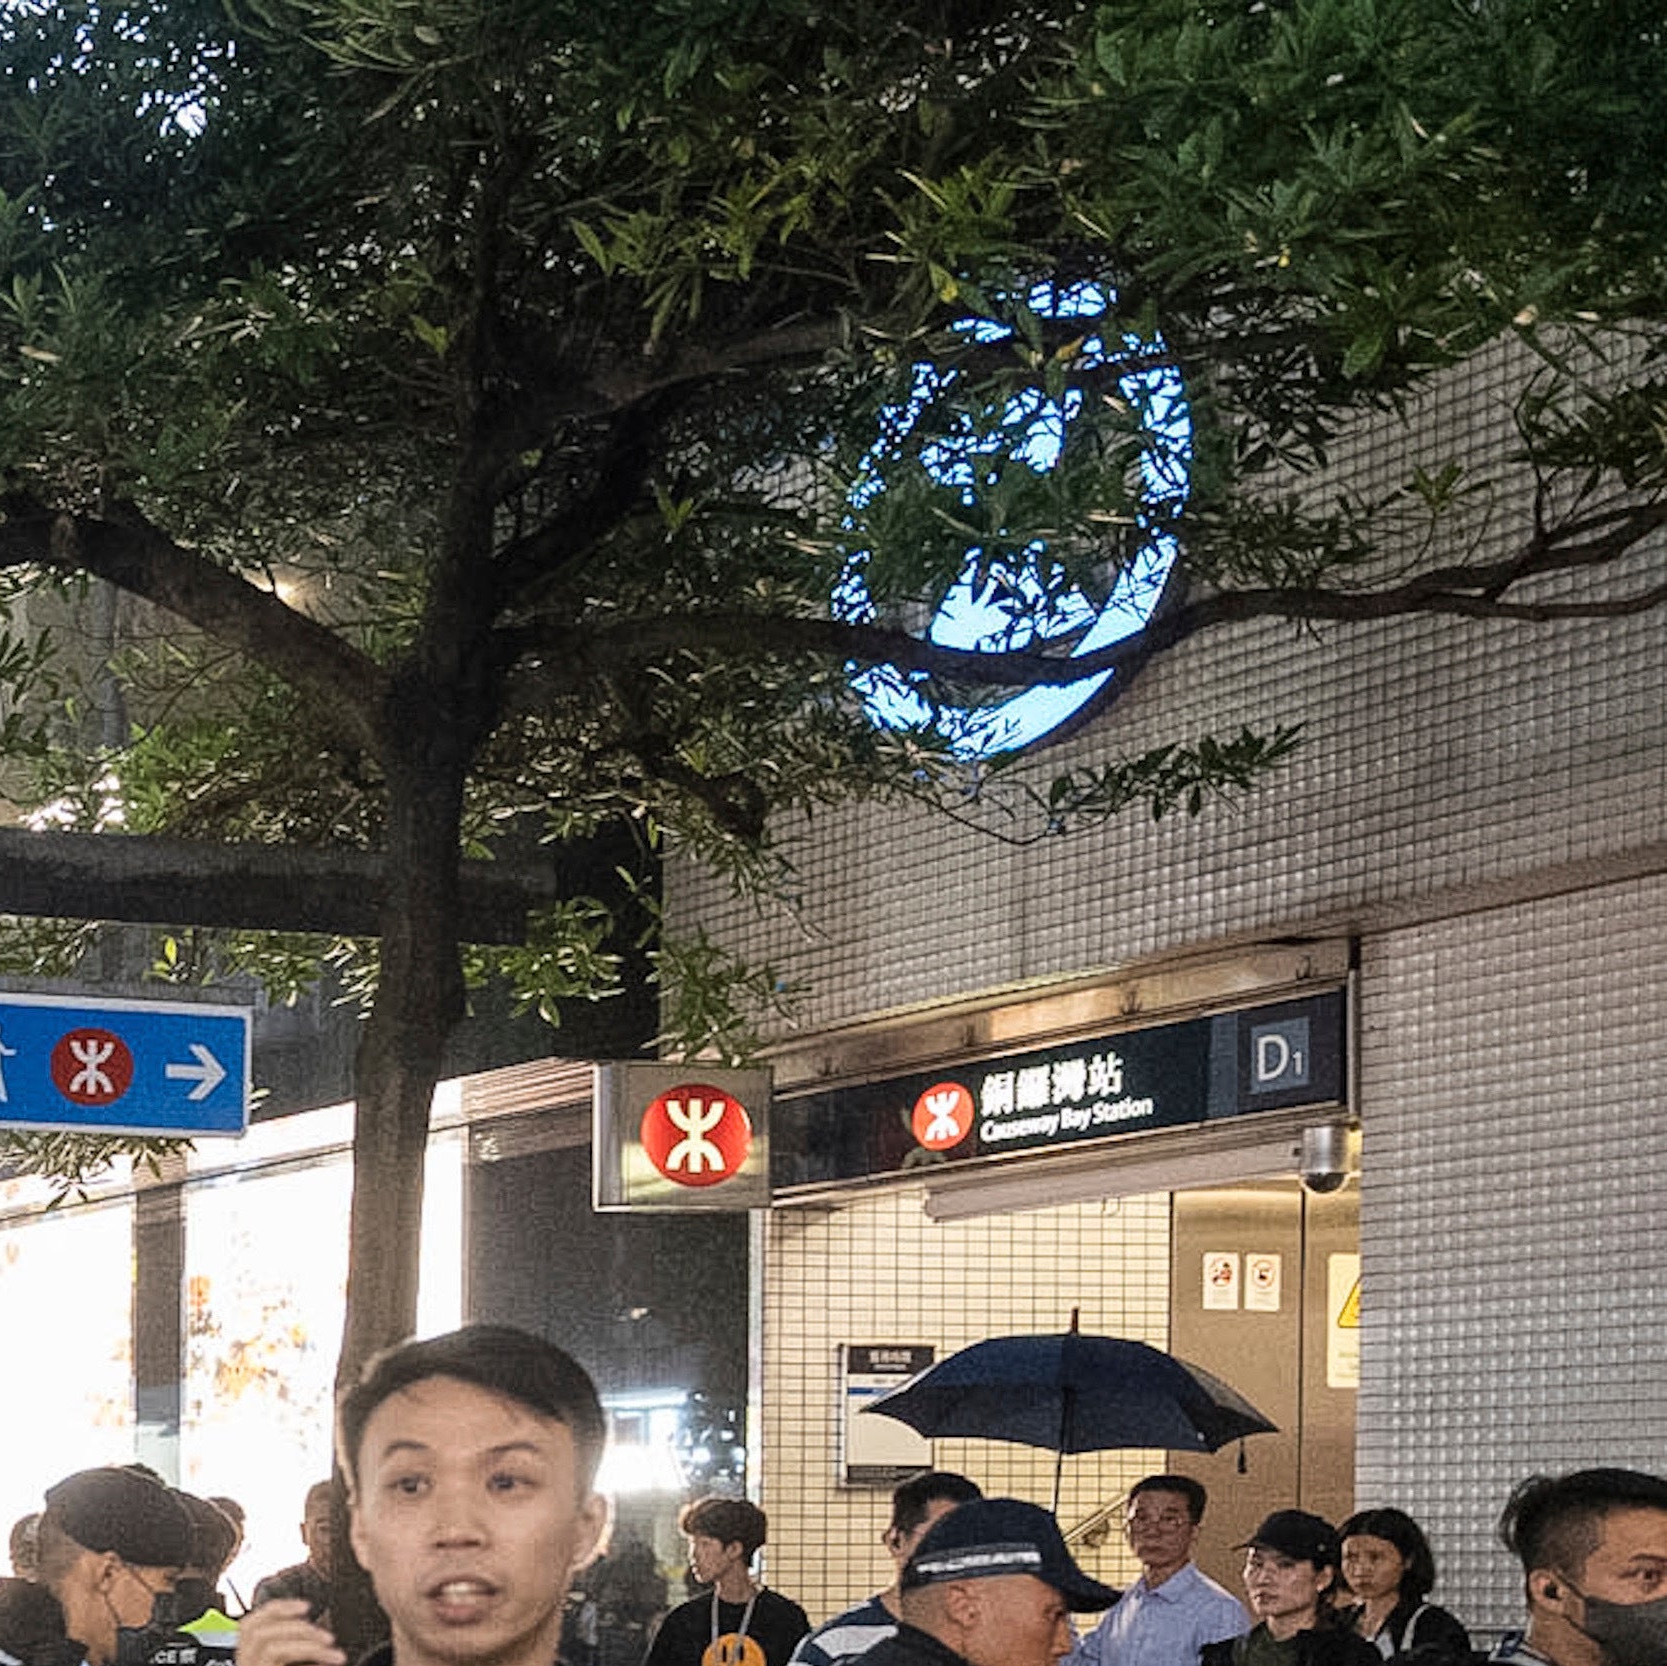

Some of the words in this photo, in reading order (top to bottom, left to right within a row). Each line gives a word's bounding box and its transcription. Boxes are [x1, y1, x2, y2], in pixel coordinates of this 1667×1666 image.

[1257, 1034, 1304, 1081] D1
[980, 1112, 1060, 1143] Causeway
[1060, 1106, 1092, 1132] Bay
[1092, 1096, 1154, 1125] Station
